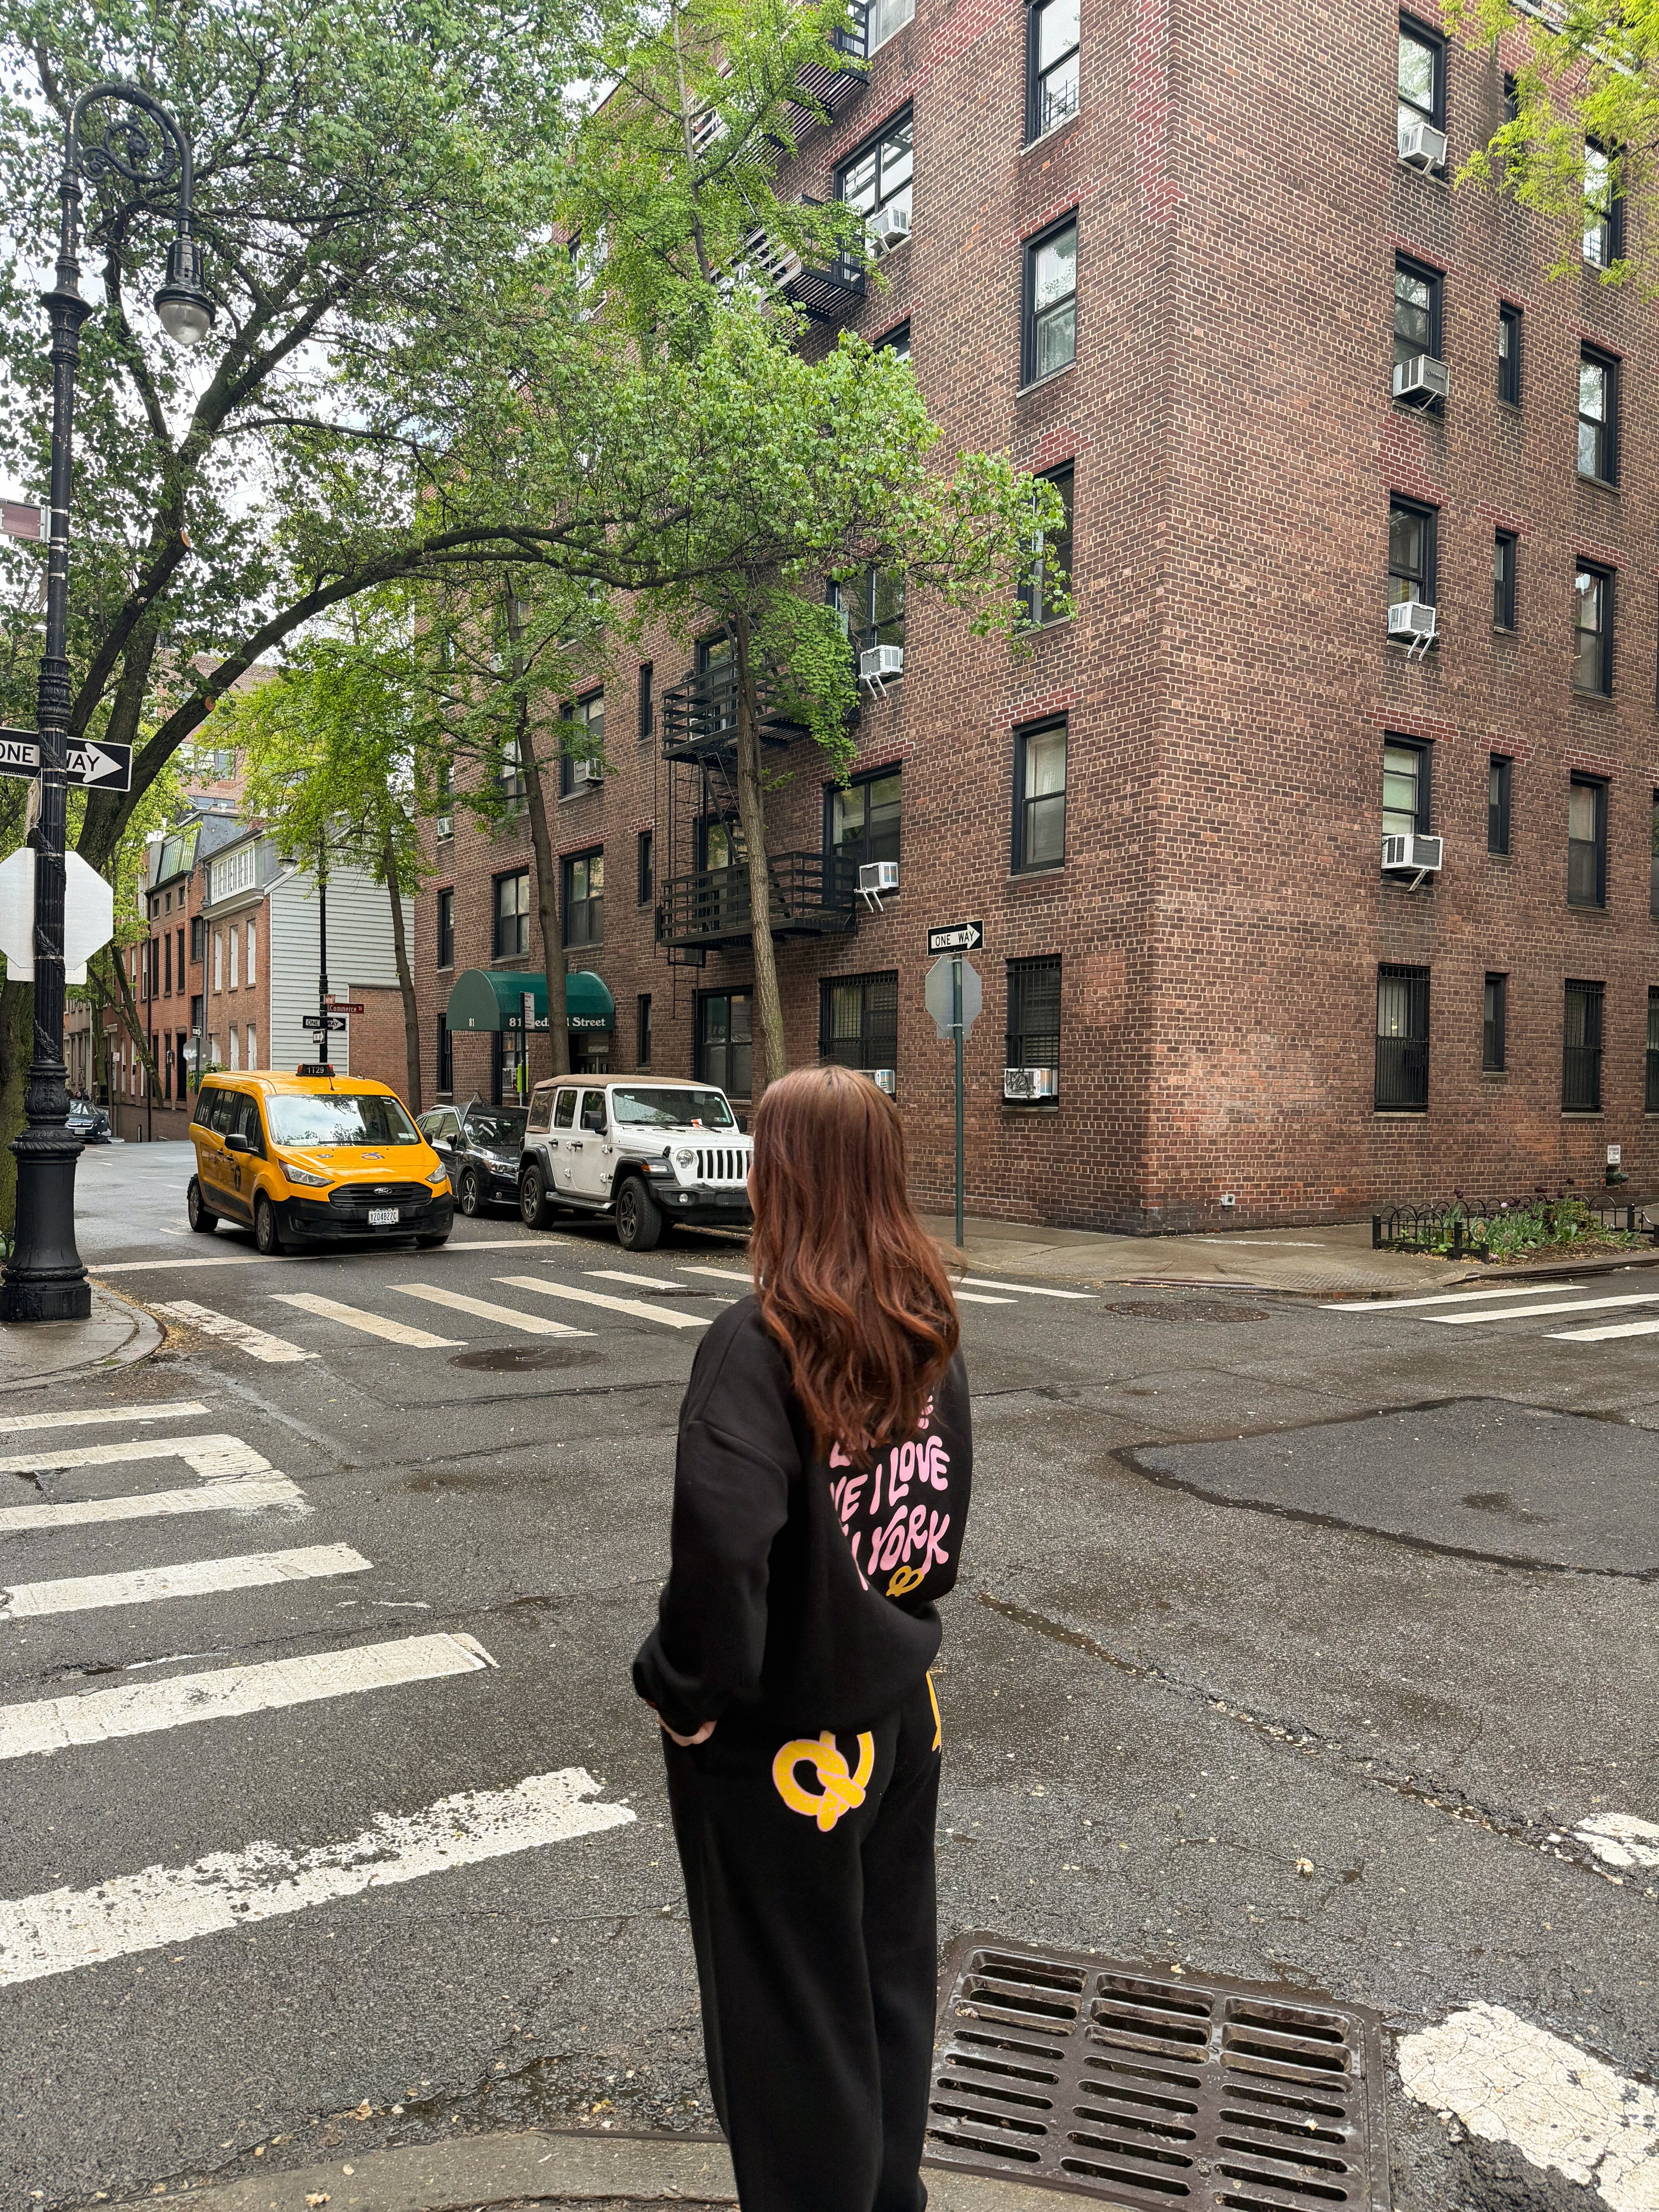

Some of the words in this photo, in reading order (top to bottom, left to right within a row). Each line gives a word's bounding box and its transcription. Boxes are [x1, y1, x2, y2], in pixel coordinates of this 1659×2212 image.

[936, 934, 951, 946] ONE
[958, 930, 974, 943] WAY
[469, 1018, 474, 1027] 81
[572, 1017, 606, 1027] Street
[889, 1436, 950, 1506] LOVE
[868, 1504, 950, 1575] YORK
